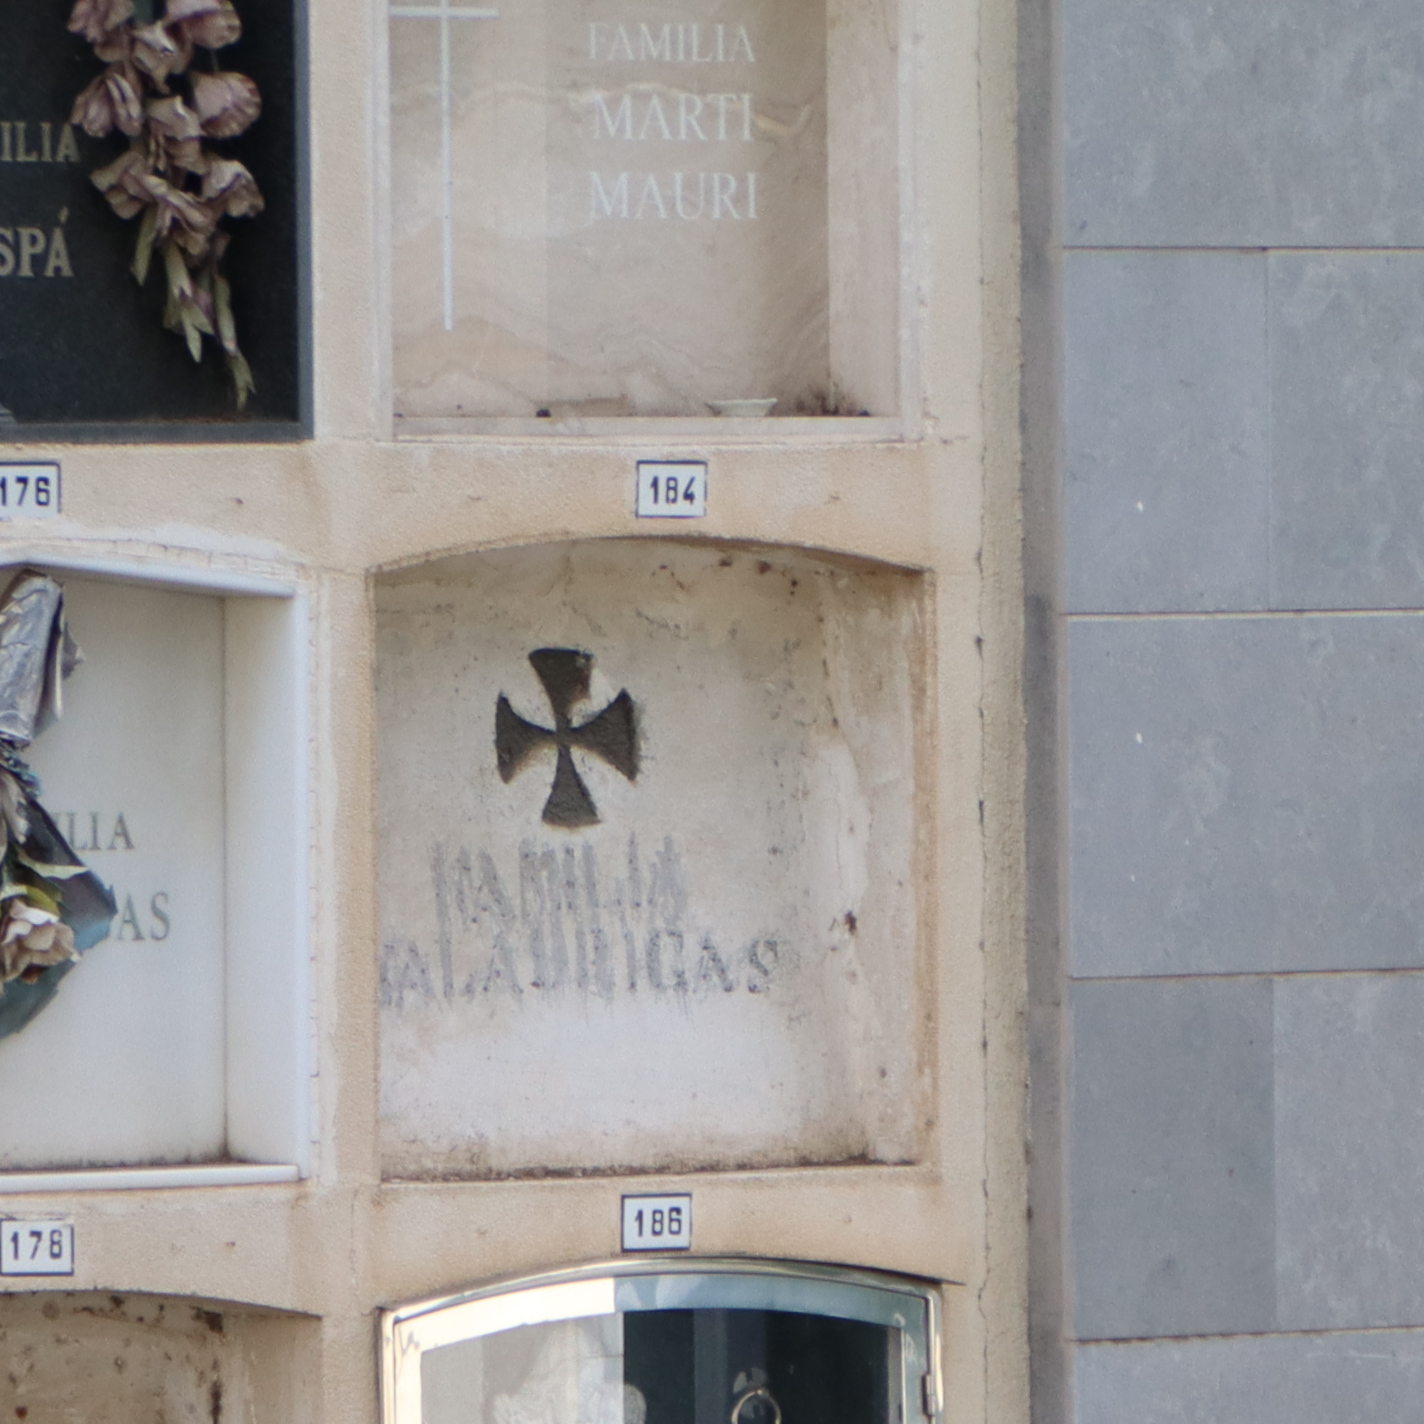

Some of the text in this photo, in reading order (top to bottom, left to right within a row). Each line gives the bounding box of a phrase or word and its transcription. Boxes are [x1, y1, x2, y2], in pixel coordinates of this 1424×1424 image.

[587, 22, 757, 64] FAMILIA
[591, 93, 756, 143] MARTI
[587, 171, 761, 221] MAURI
[649, 475, 697, 504] 184
[634, 1207, 683, 1238] 186
[9, 1229, 64, 1260] 178
